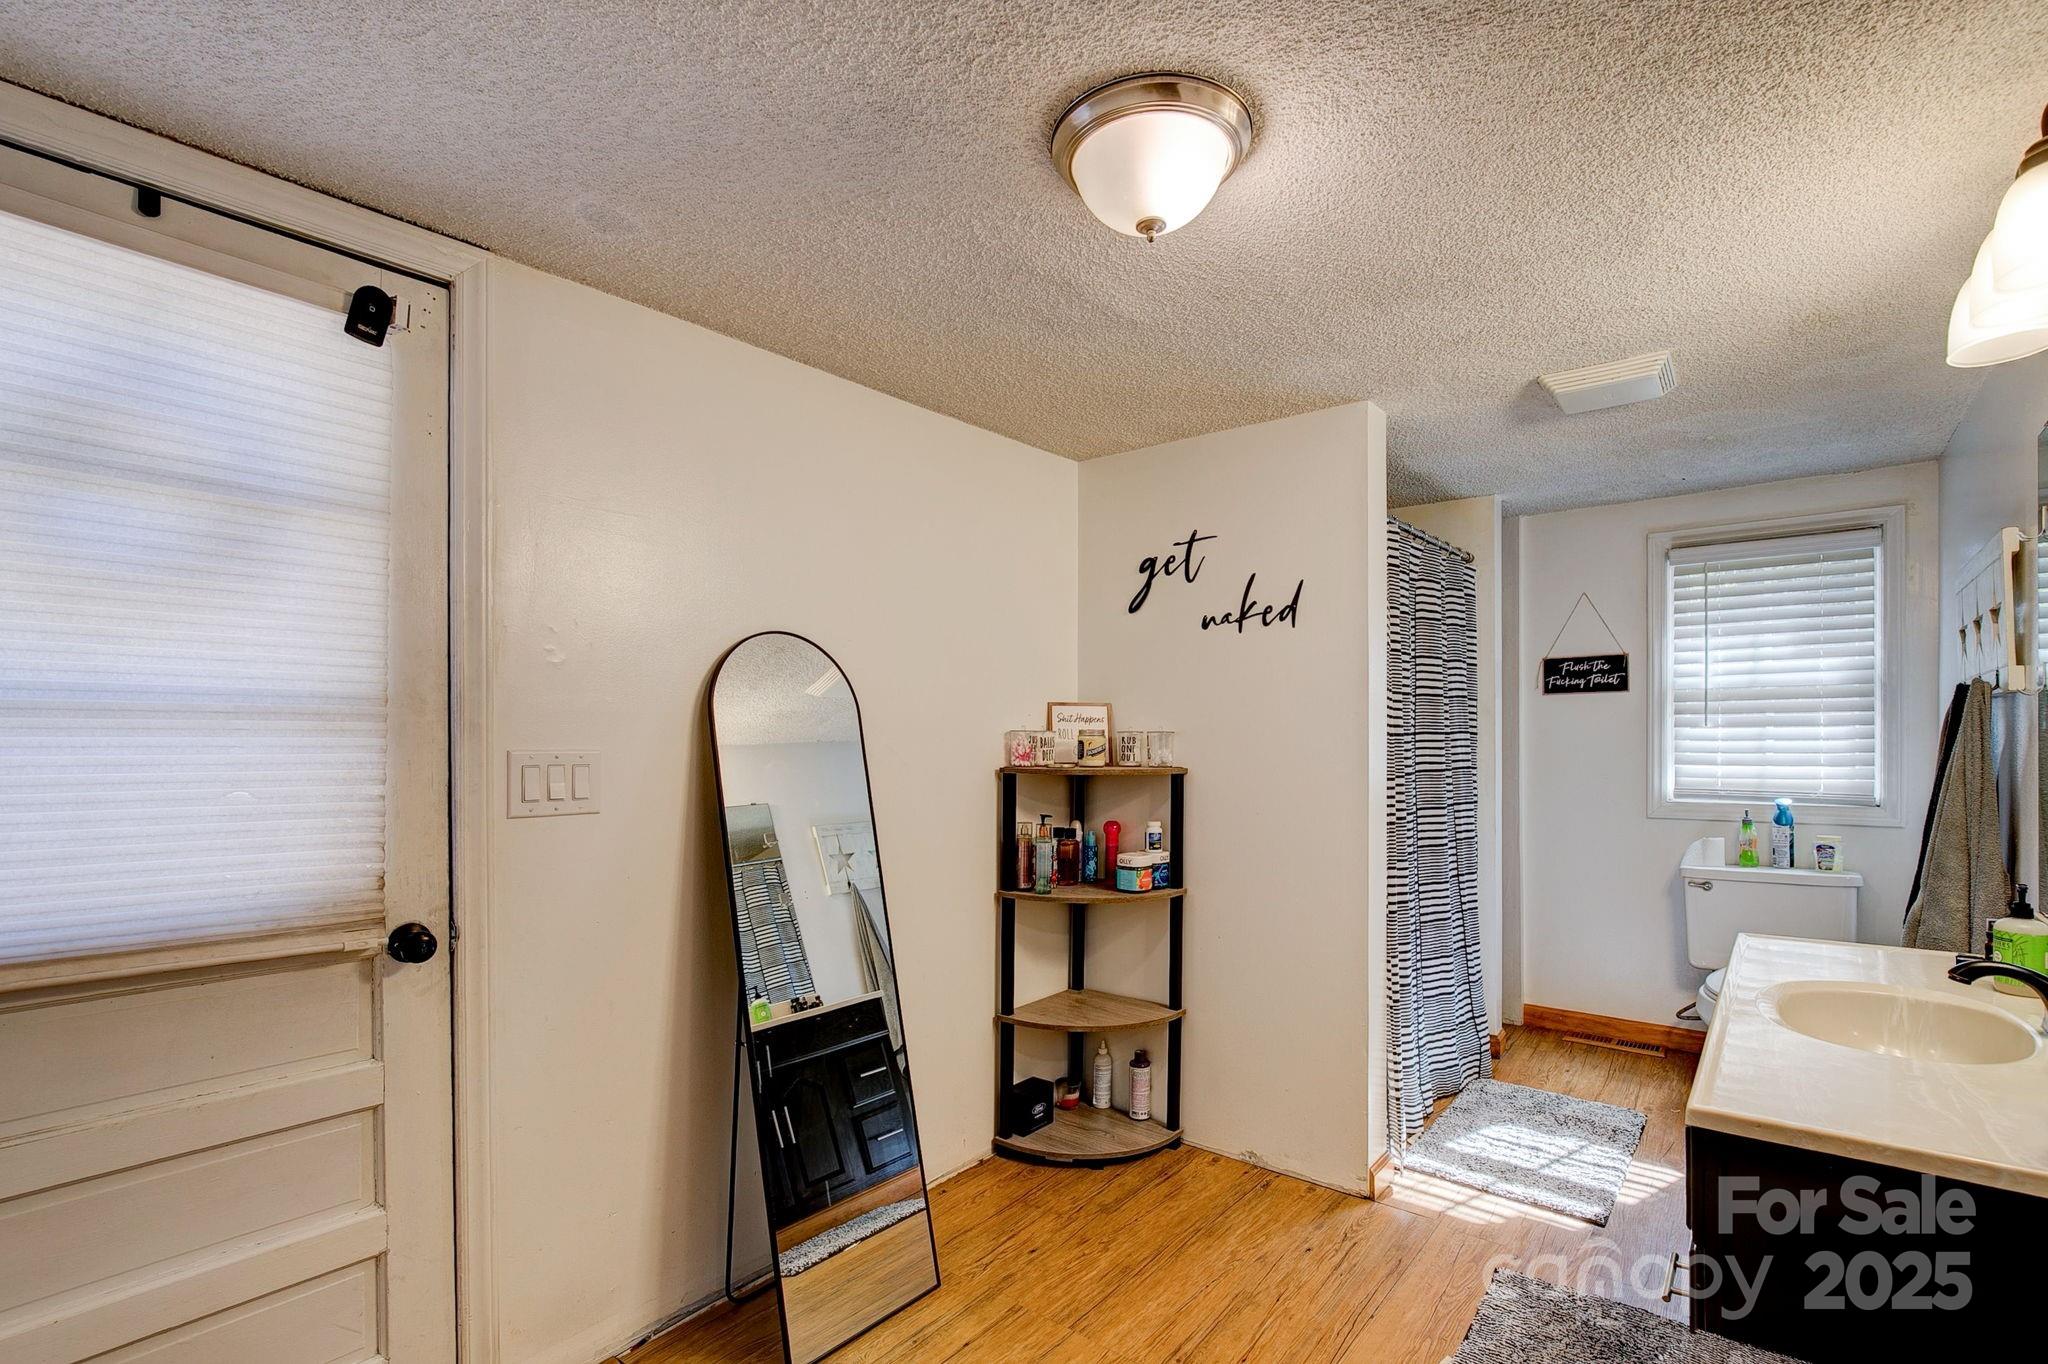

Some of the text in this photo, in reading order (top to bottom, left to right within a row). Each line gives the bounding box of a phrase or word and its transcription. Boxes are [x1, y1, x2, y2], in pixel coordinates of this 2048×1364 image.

[1128, 529, 1218, 614] get
[1201, 572, 1304, 634] naked
[1545, 672, 1626, 689] Fucking Toilet
[1121, 736, 1137, 745] RUB
[1120, 753, 1136, 762] OUT
